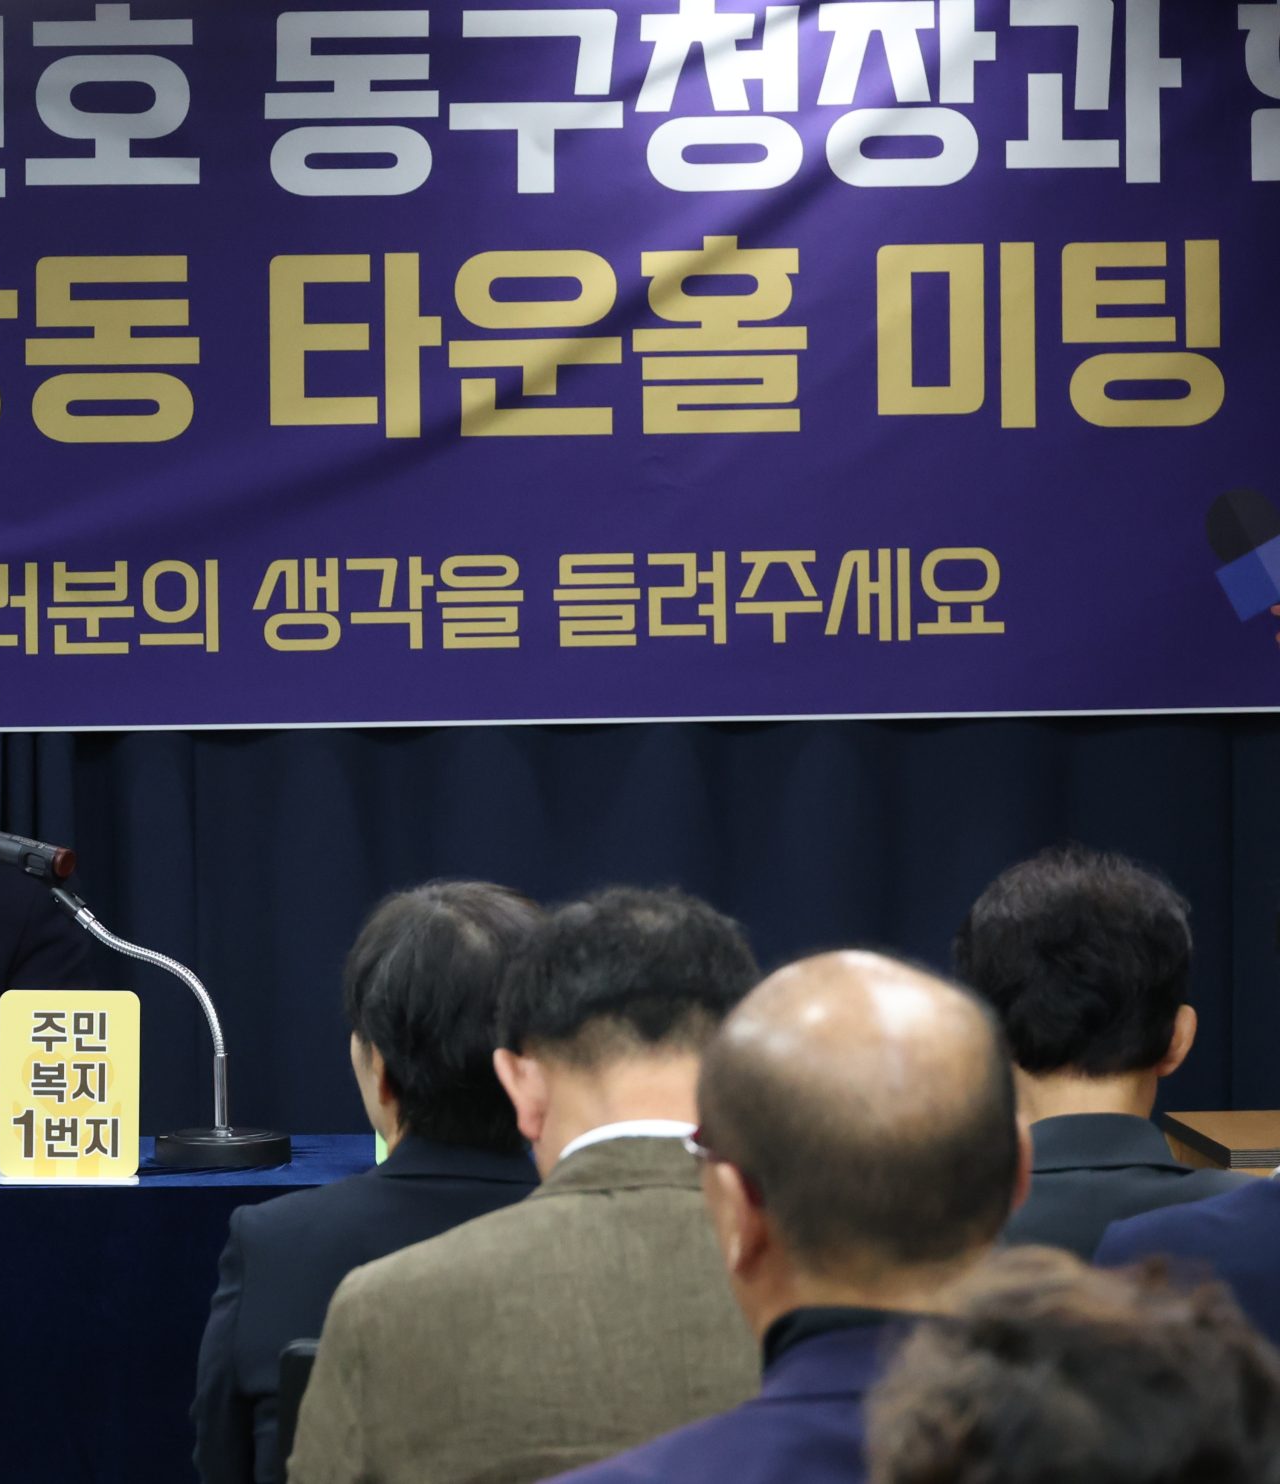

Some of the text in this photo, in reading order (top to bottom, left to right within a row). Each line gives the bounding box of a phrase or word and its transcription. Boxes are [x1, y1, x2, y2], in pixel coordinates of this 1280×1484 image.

[264, 0, 1182, 196] 동구청장과
[269, 235, 808, 439] 타운홀
[876, 239, 1225, 429] 미팅
[252, 554, 524, 652] 생각을
[552, 547, 1005, 648] 들려주세요
[31, 1012, 107, 1053] 주민
[30, 1062, 106, 1103] 복지
[12, 1109, 119, 1158] 1번지
